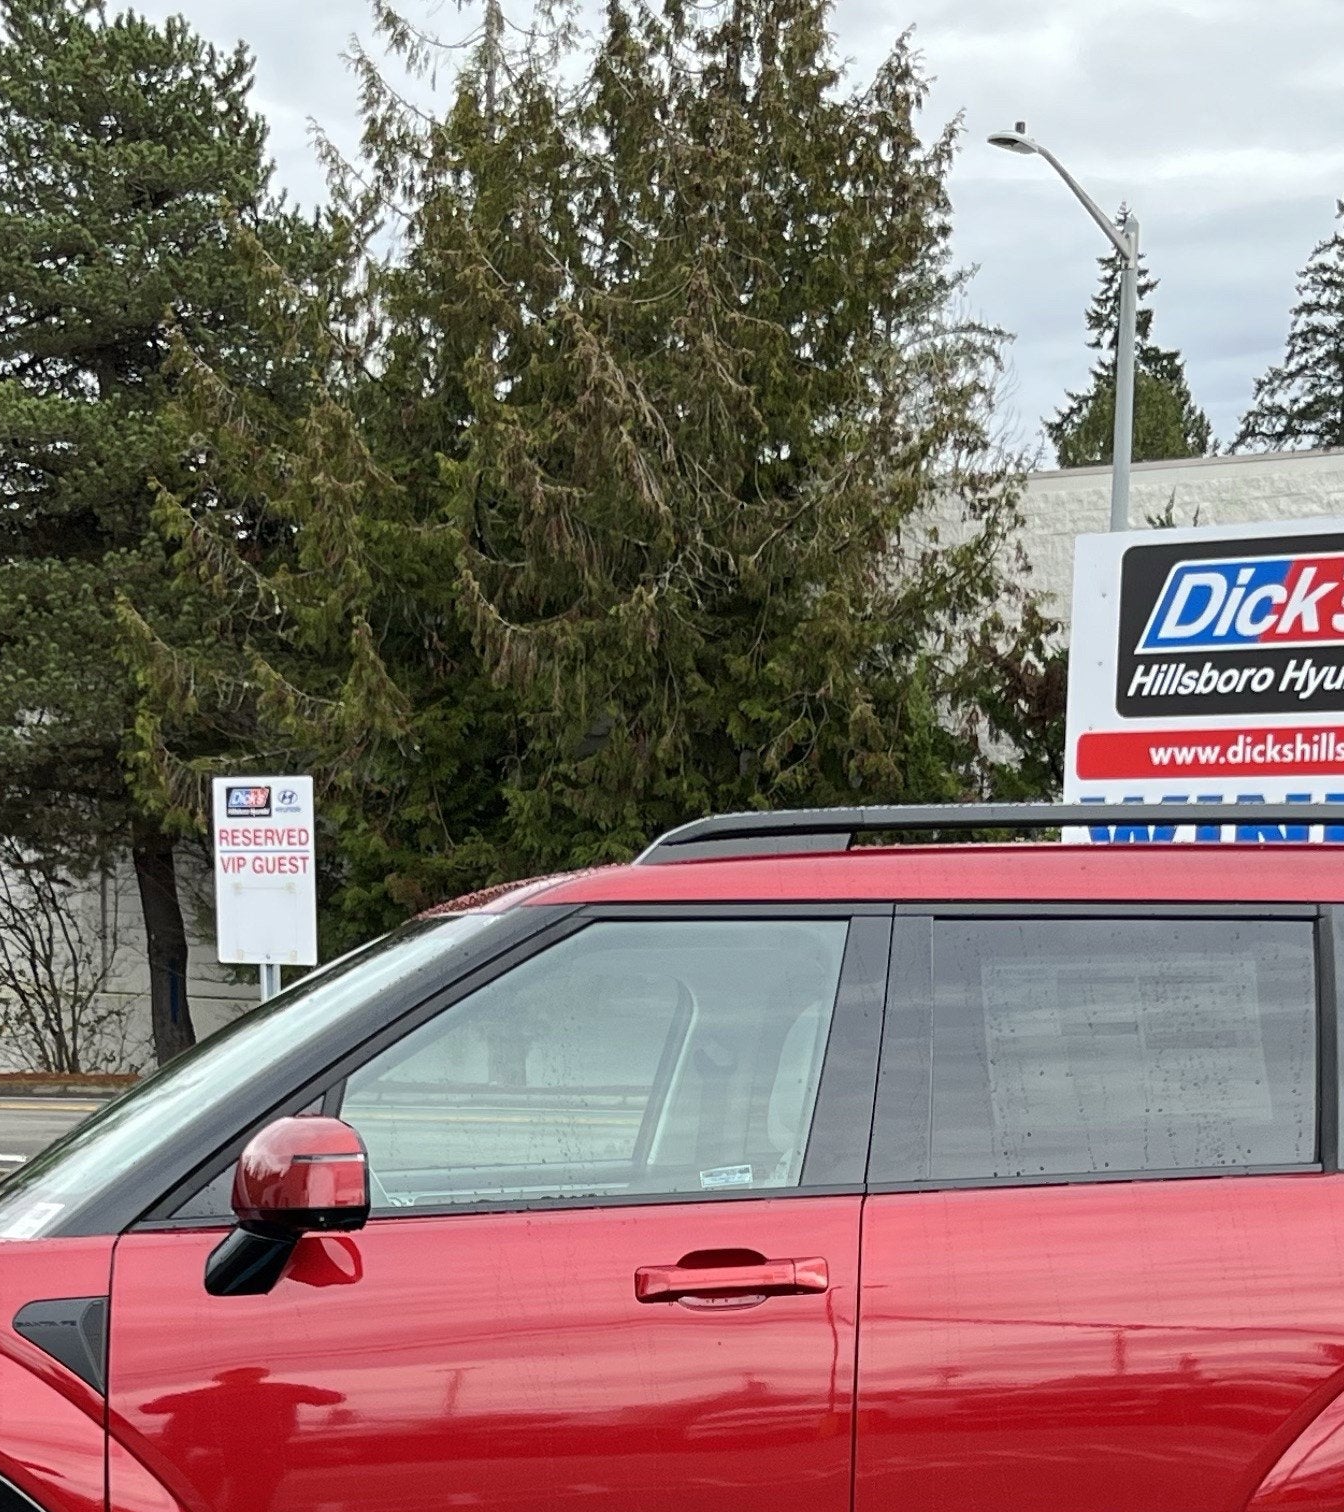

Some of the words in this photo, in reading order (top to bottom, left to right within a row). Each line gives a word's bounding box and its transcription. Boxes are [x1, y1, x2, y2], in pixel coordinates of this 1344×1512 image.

[1127, 661, 1275, 697] Hillsboro
[218, 829, 310, 847] RESERVED
[220, 856, 247, 874] VIP
[252, 856, 310, 875] GUEST
